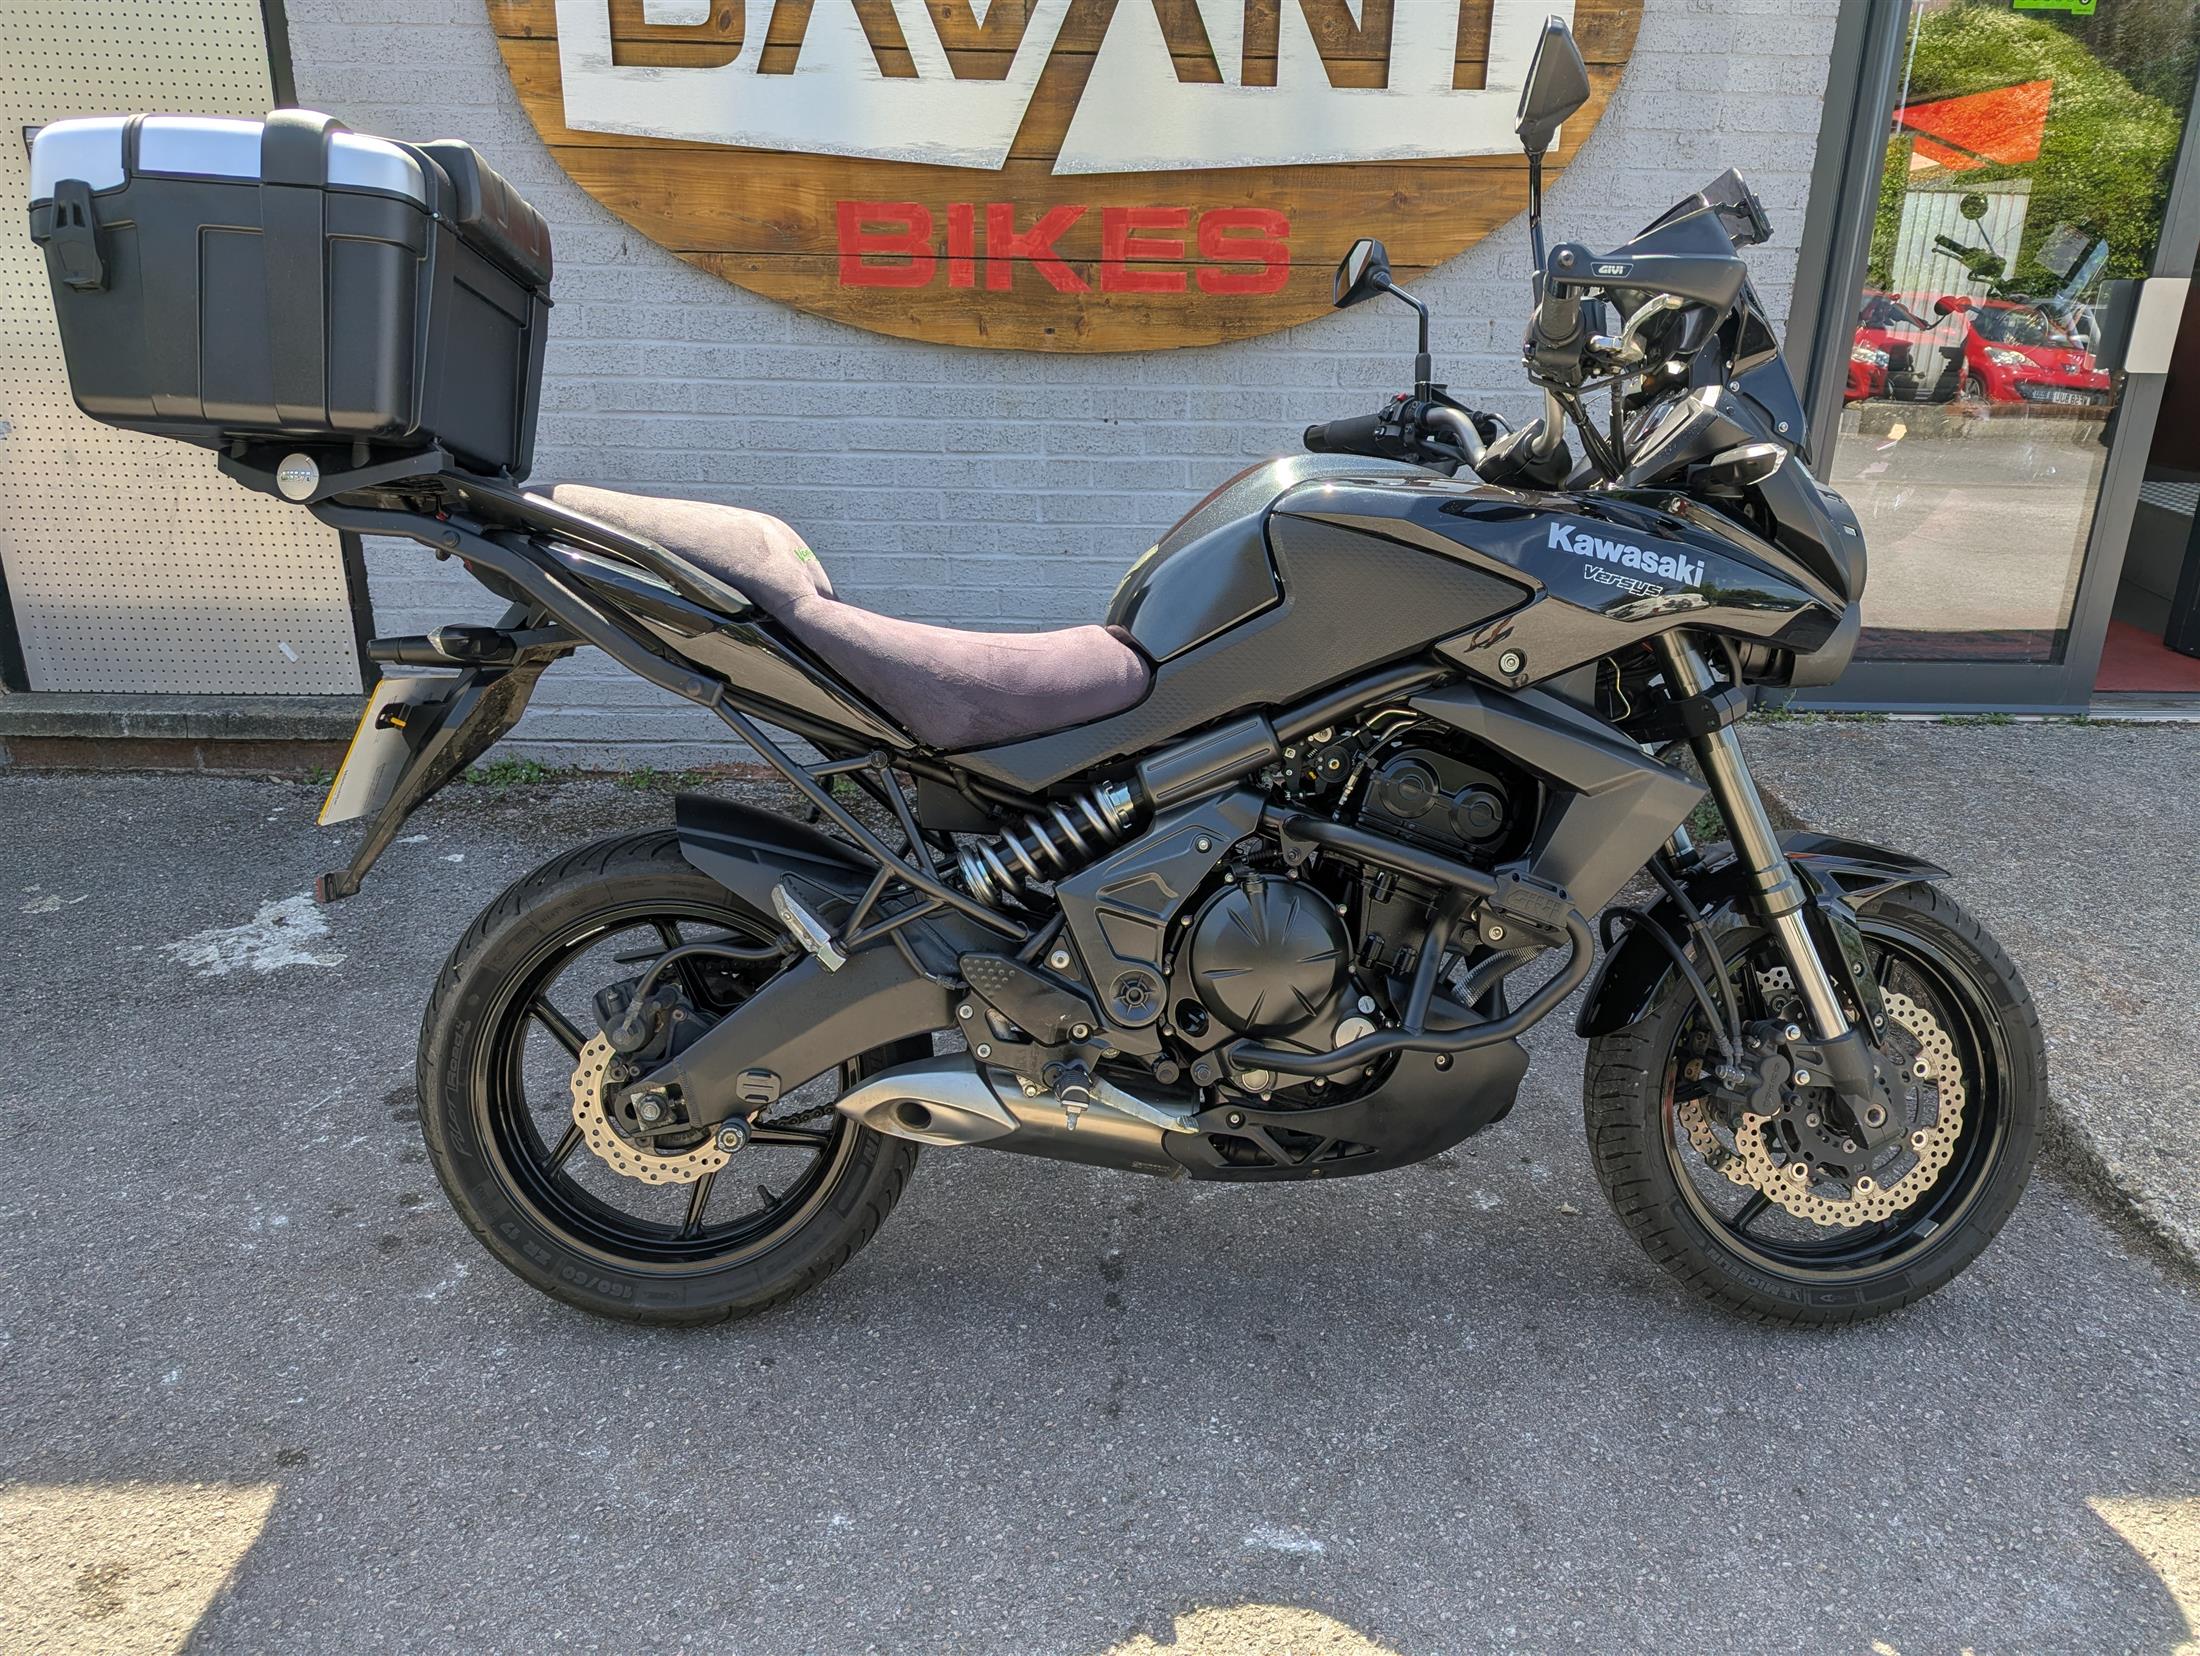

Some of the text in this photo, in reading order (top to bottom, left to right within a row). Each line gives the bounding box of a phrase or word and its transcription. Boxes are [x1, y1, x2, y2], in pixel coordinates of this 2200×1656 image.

[837, 201, 1291, 295] BIKES
[1598, 265, 1624, 275] GIVI
[1548, 521, 1705, 588] Kawasaki
[1583, 563, 1664, 597] Versys
[522, 1240, 553, 1266] ZR
[561, 1265, 633, 1298] 160/60
